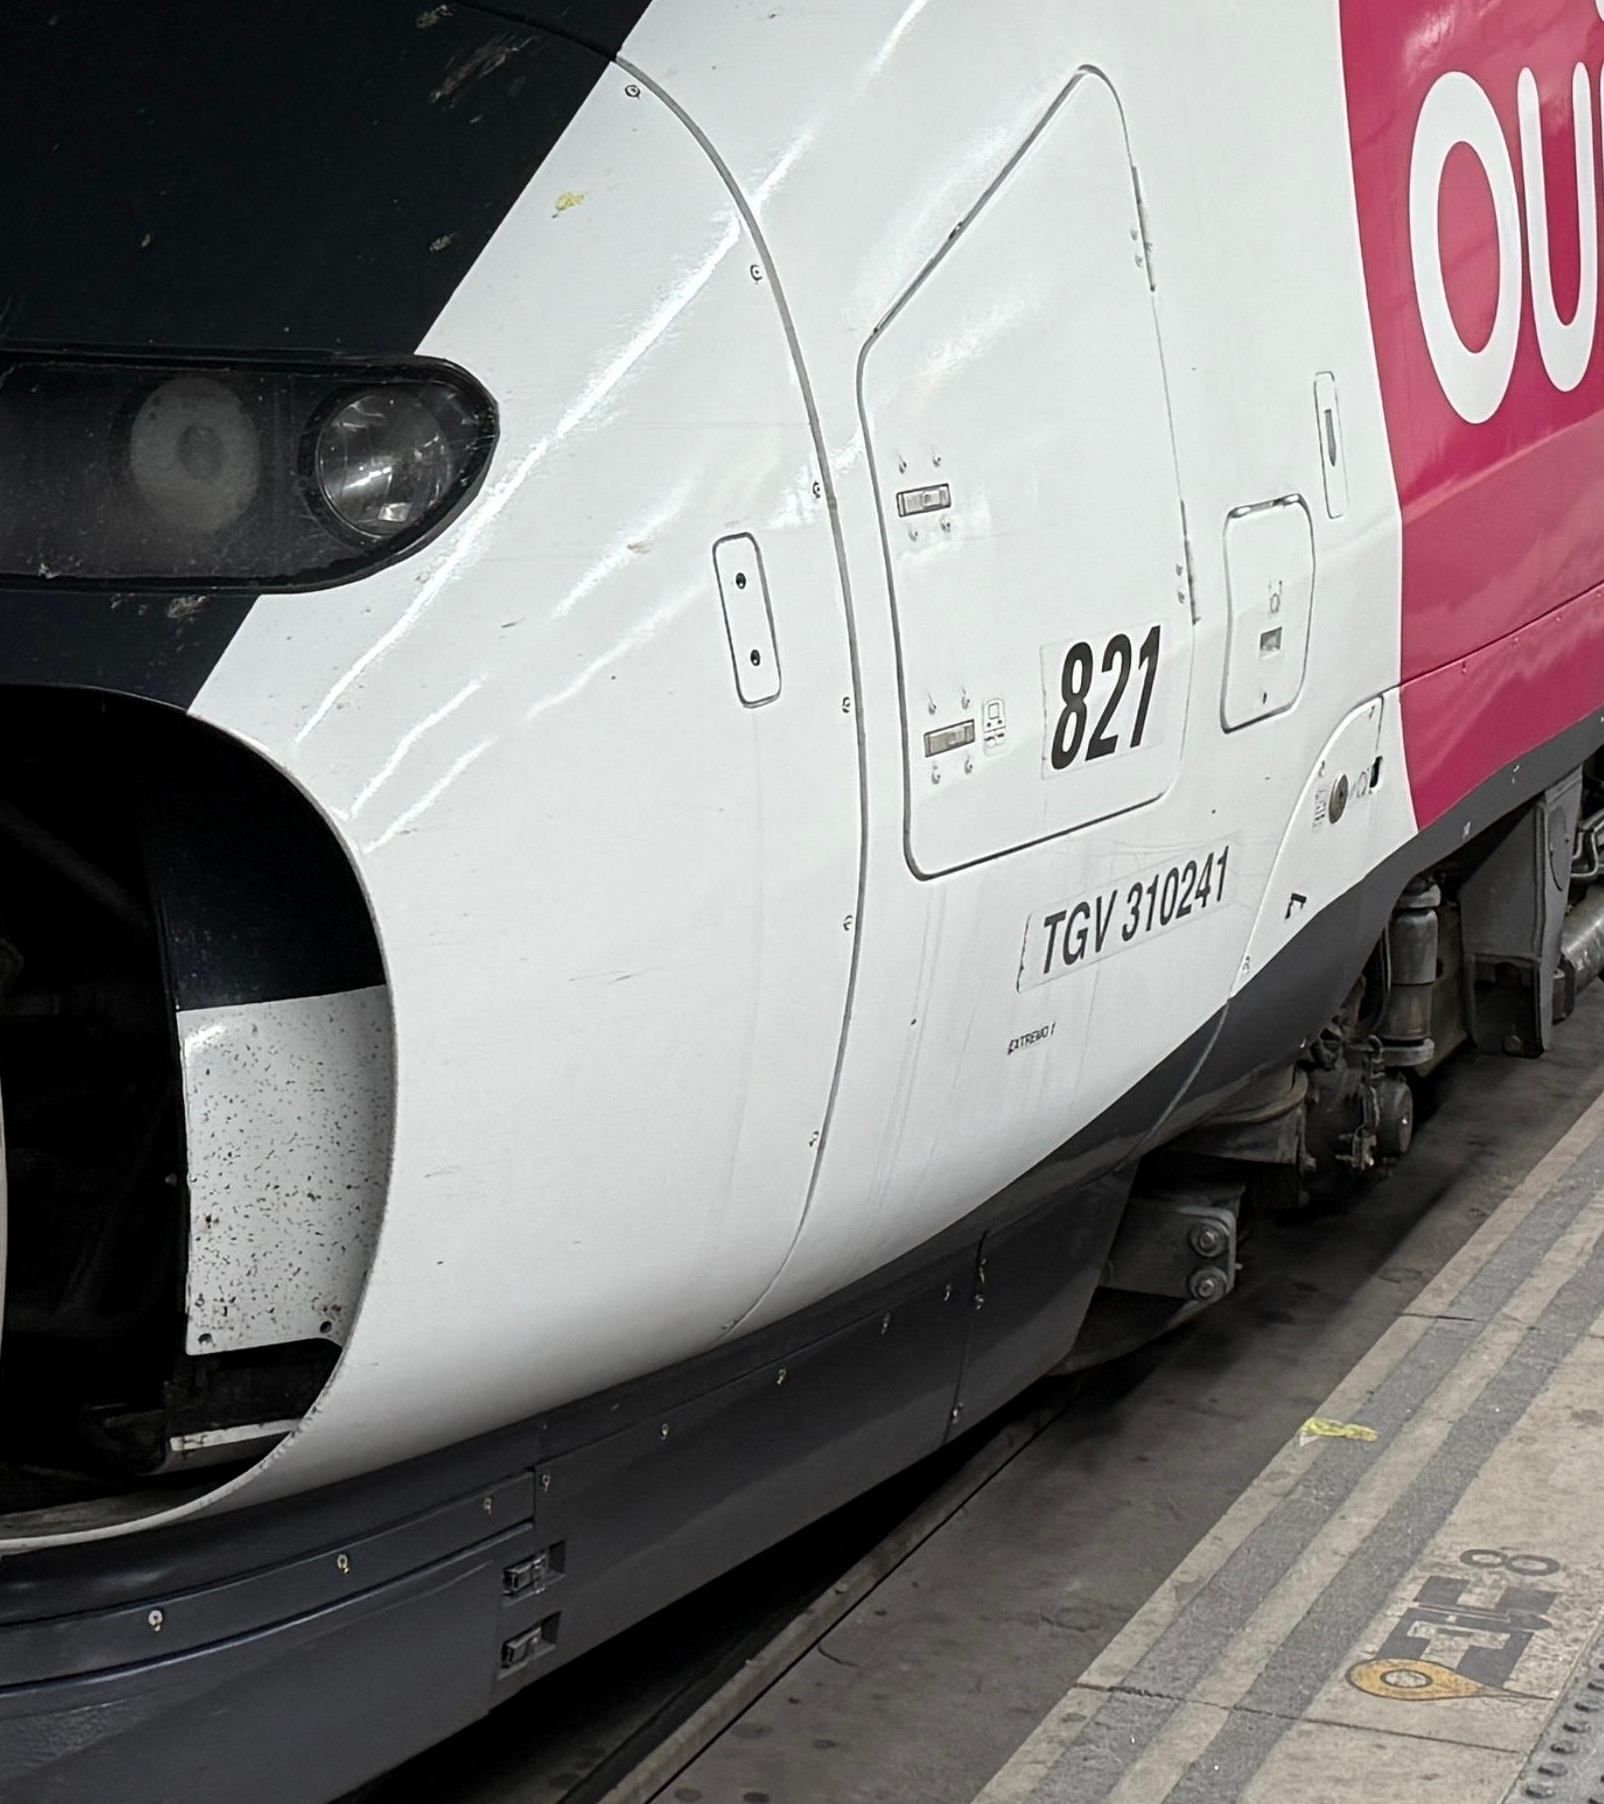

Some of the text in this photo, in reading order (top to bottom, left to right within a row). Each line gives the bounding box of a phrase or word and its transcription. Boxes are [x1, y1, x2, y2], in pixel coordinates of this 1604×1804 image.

[1050, 626, 1161, 771] 821
[1043, 845, 1229, 974] TGV 310241
